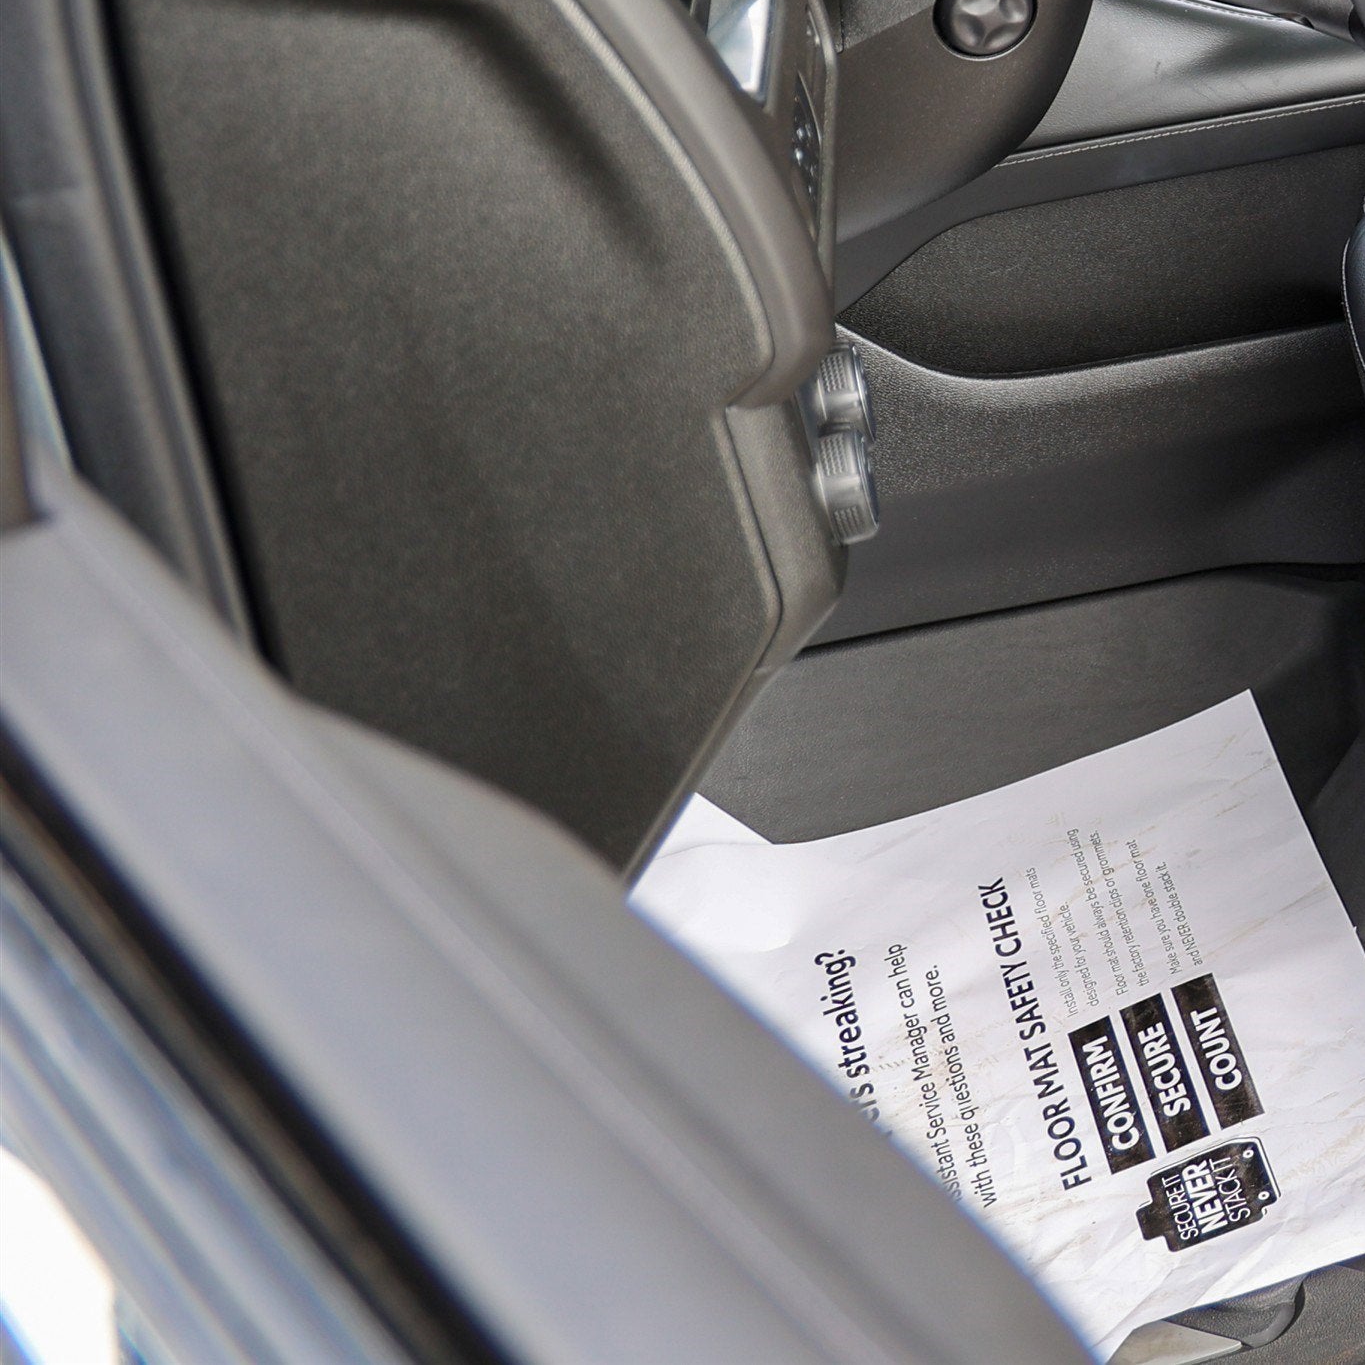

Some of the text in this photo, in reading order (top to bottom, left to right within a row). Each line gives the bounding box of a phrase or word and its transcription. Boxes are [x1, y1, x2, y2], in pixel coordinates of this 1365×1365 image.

[1026, 868, 1078, 1017] Install only the specified floor mats
[1058, 905, 1099, 1006] designed for your vehicle.
[1067, 829, 1128, 995] Floor mat should always be secured using
[1089, 830, 1149, 986] the factory retention clips or grommets.
[1125, 840, 1182, 974] Make sure you have one floor mat
[1155, 862, 1203, 966] and NEVER double stack it.
[814, 950, 869, 1078] streaking?
[884, 944, 963, 1203] ssistant Service Manager can help
[978, 877, 1092, 1190] FLOOR MAT SAFETY CHECK
[1138, 1022, 1190, 1116] SECURE
[1191, 1008, 1242, 1090] COUNT
[926, 965, 997, 1208] with these questions and more.
[1083, 1036, 1139, 1150] CONFIRM
[1162, 1175, 1198, 1240] SECURE IT
[1182, 1159, 1227, 1233] NEVER
[1209, 1157, 1250, 1221] STACK IT
